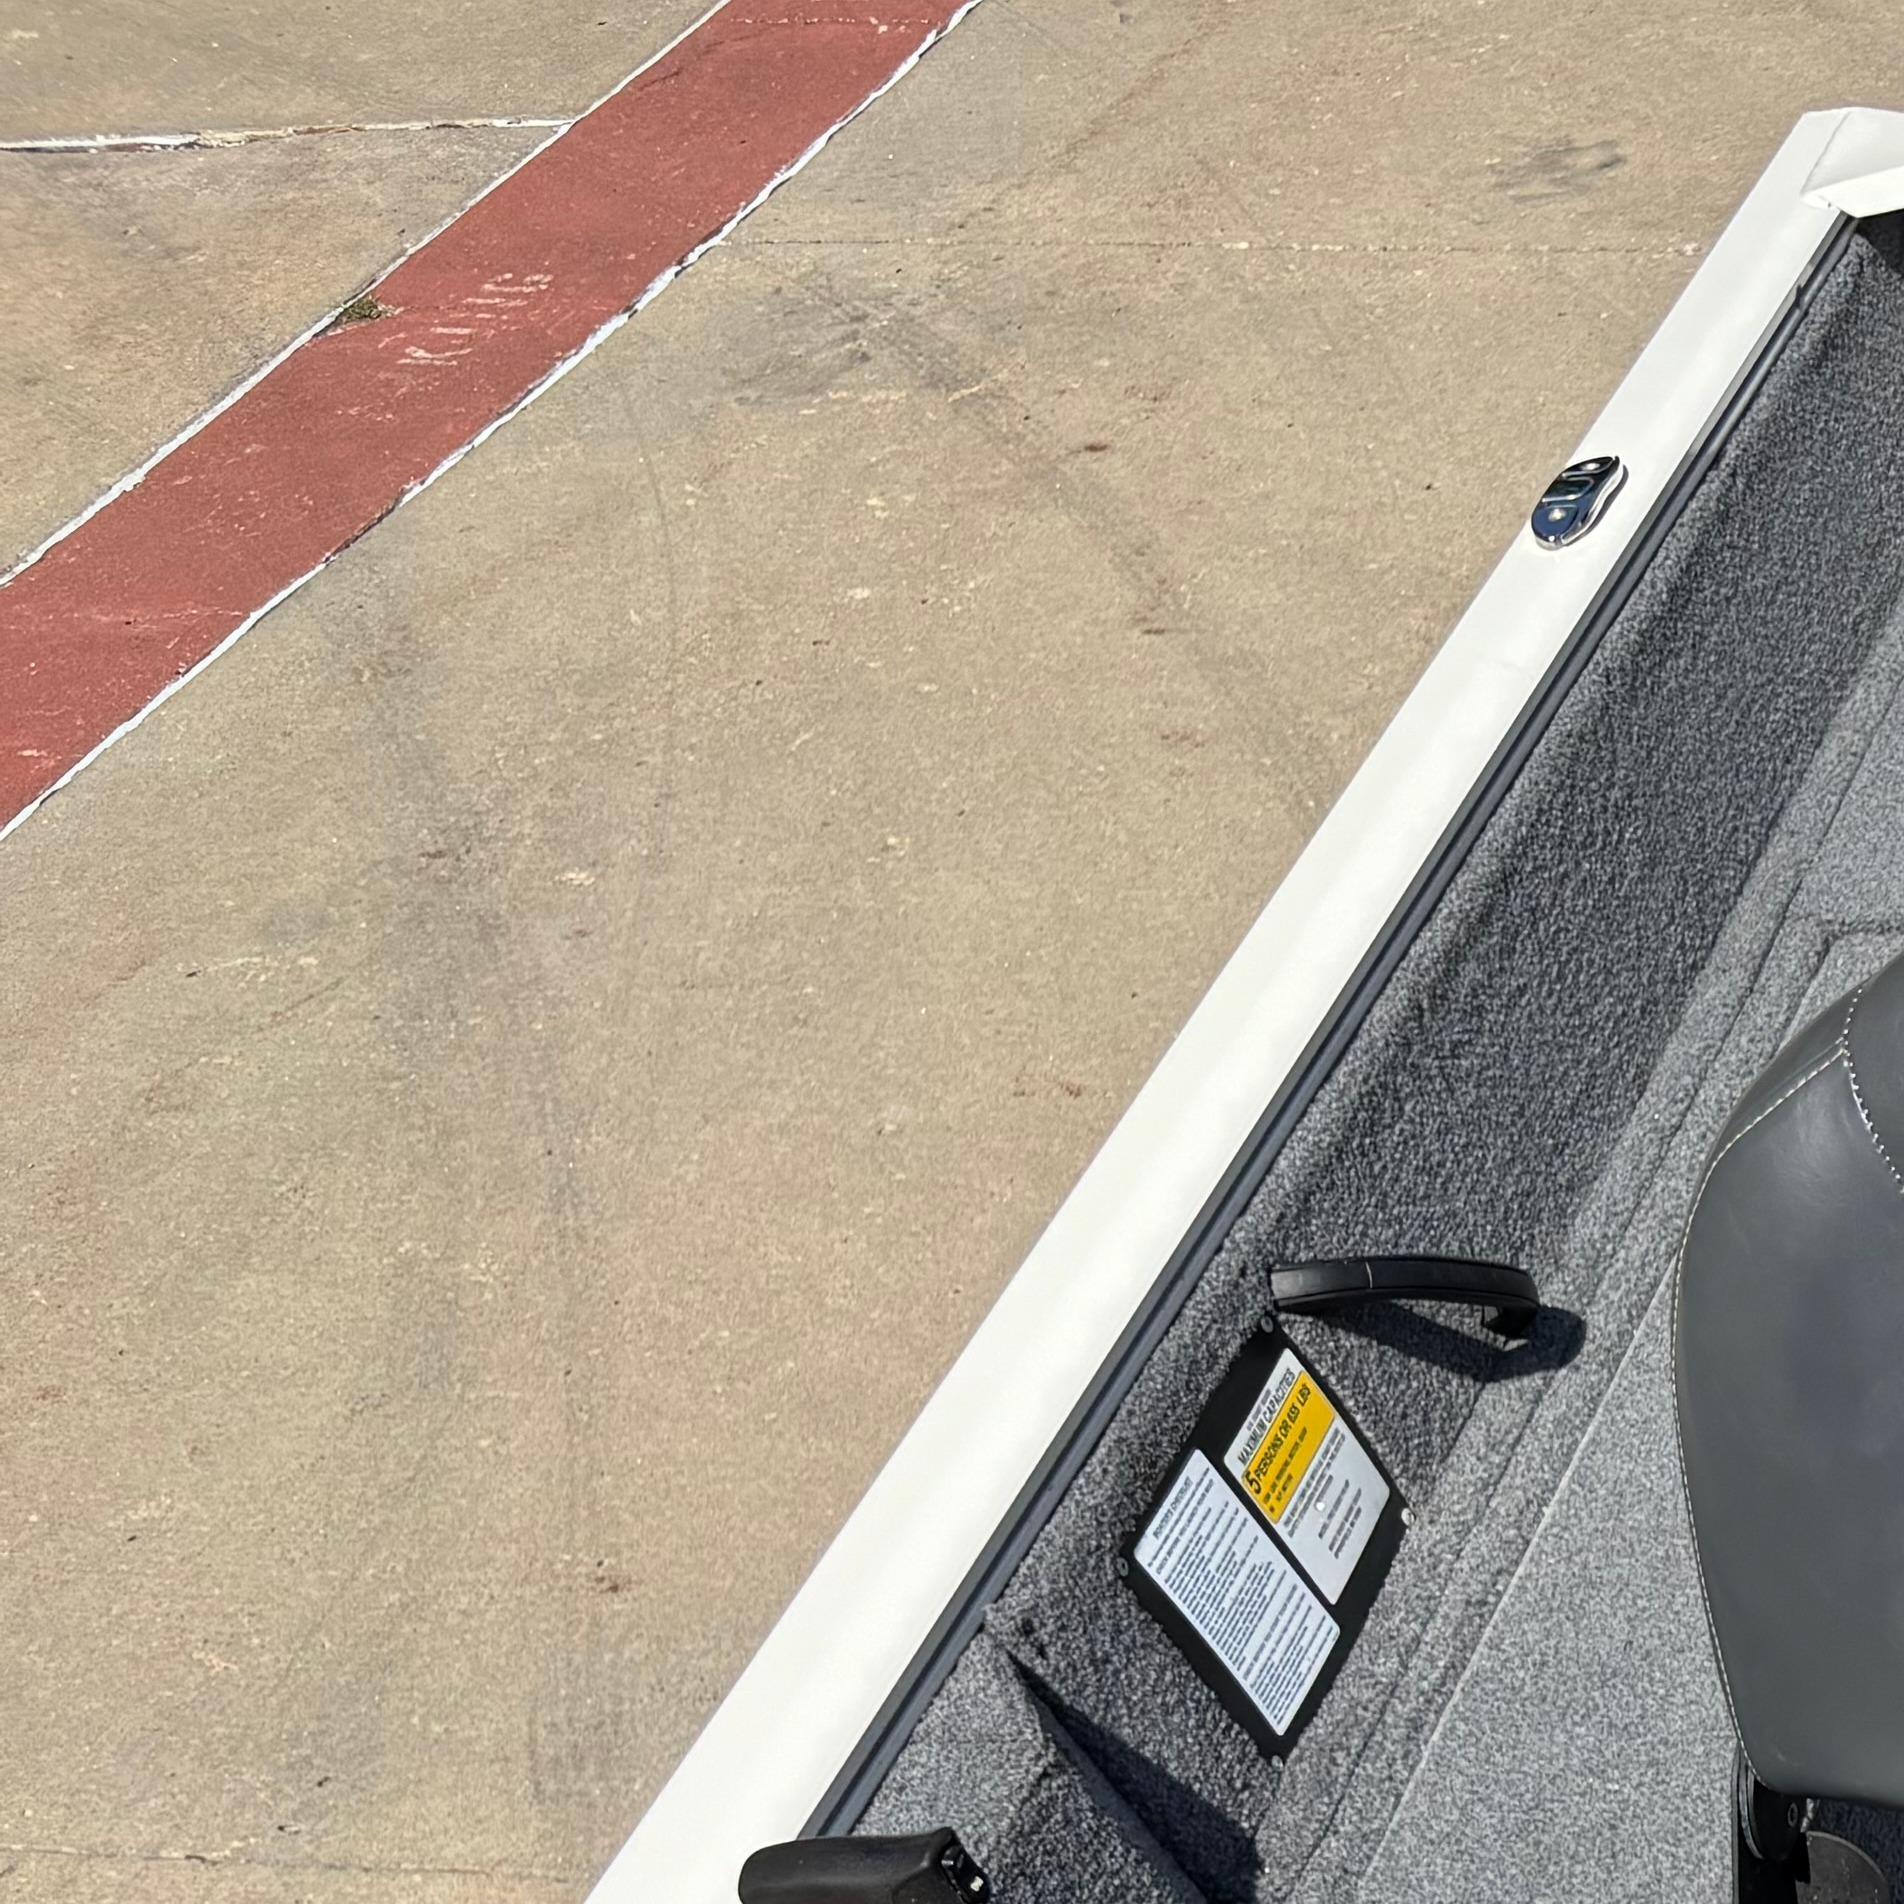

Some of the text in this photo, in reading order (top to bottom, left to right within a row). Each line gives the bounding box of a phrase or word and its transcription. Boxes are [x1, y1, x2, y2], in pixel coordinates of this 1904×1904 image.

[1245, 1471, 1261, 1494] 5
[1255, 1434, 1284, 1481] PERSONS
[1280, 1418, 1292, 1438] OR
